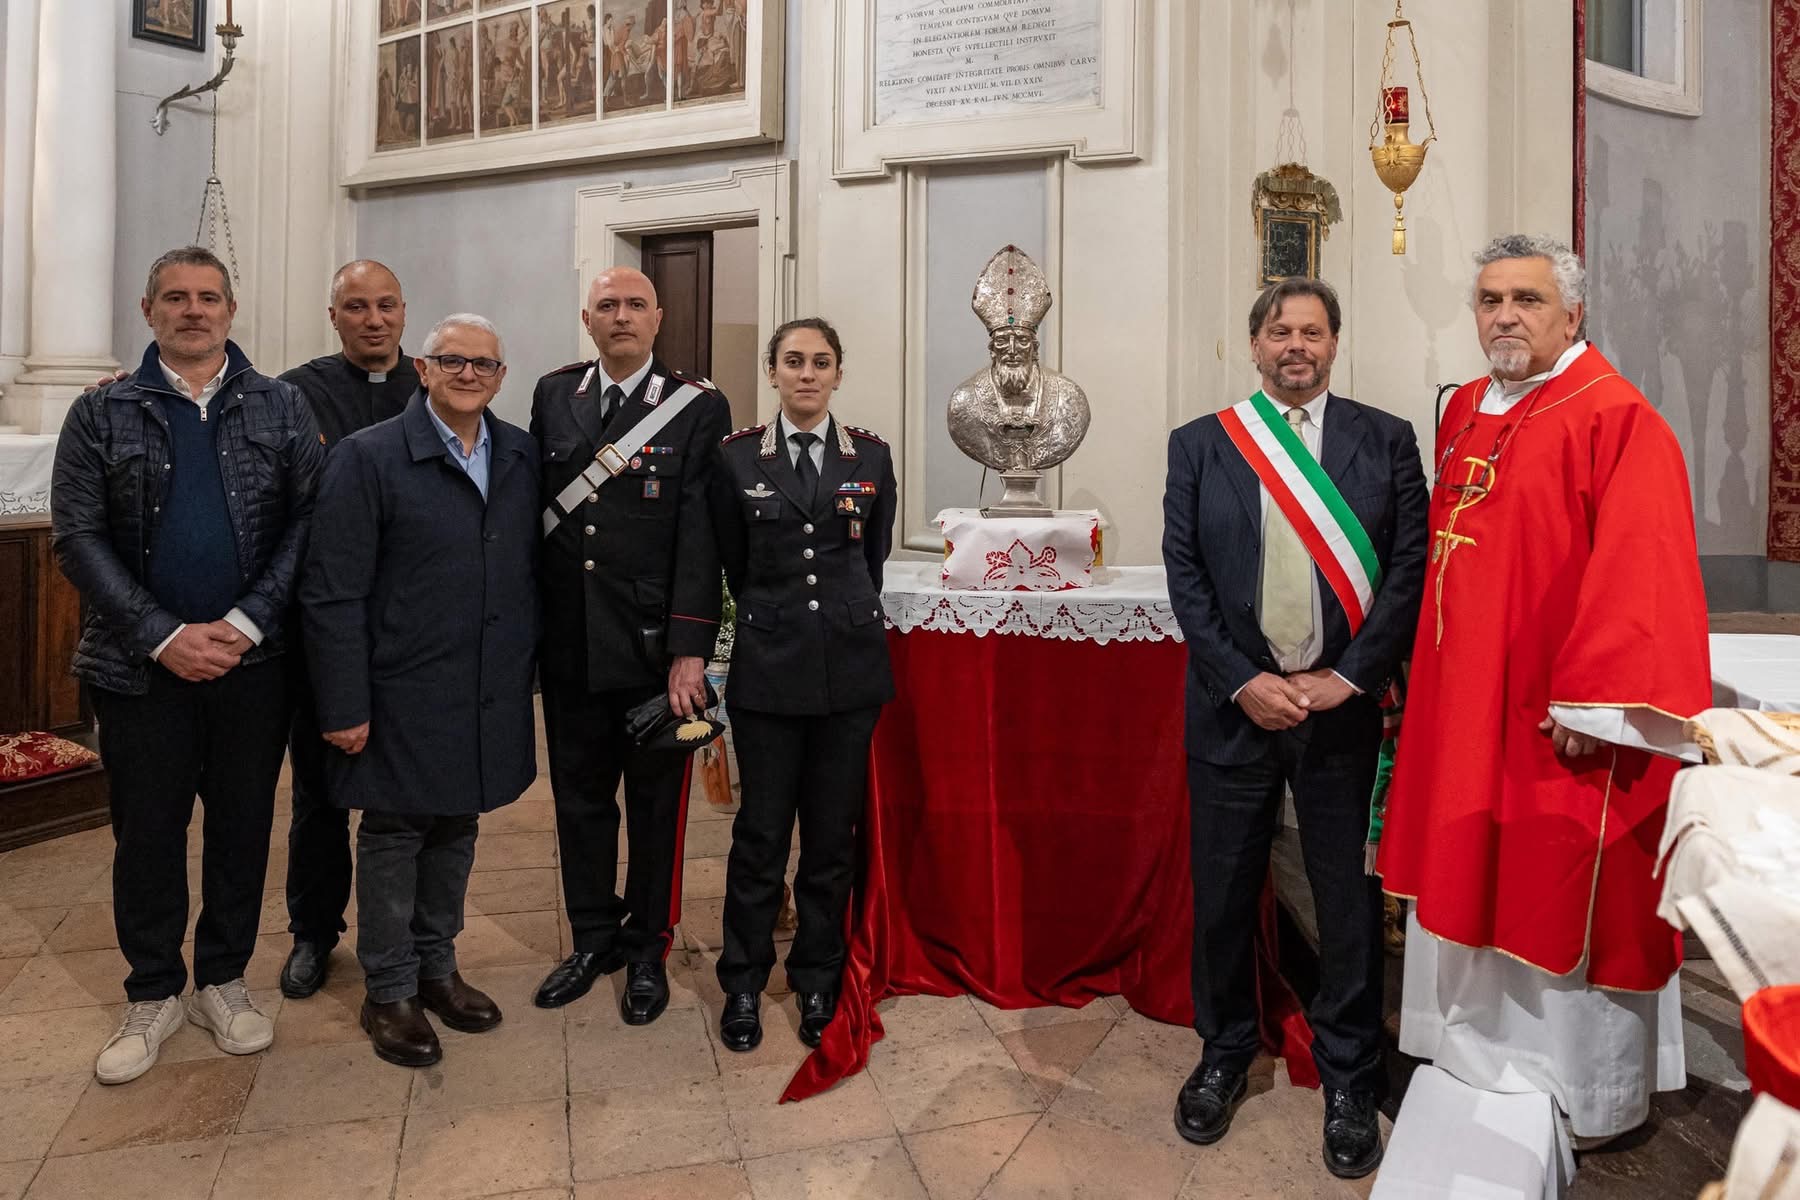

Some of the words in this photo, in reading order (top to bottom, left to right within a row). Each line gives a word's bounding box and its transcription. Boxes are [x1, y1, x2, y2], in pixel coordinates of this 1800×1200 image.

[920, 20, 952, 30] TEMPLVM
[956, 14, 1000, 26] CONTIGVAM
[1003, 11, 1018, 23] QVE
[1022, 6, 1051, 16] DOMVM
[925, 30, 980, 42] ELEGANTIOREM
[985, 24, 1018, 35] FORMAM
[913, 48, 943, 58] HONESTA
[946, 46, 960, 57] QVE
[965, 39, 1013, 50] SVPELLECTILI
[1016, 33, 1056, 45] INSTRVXIT
[880, 77, 914, 88] RELIGIONE
[918, 73, 951, 83] COMITATE
[956, 66, 1003, 78] INTEGRITATE
[1033, 60, 1066, 70] OMNIBVS
[1070, 56, 1096, 66] CARVS
[926, 86, 946, 95] VIXIT
